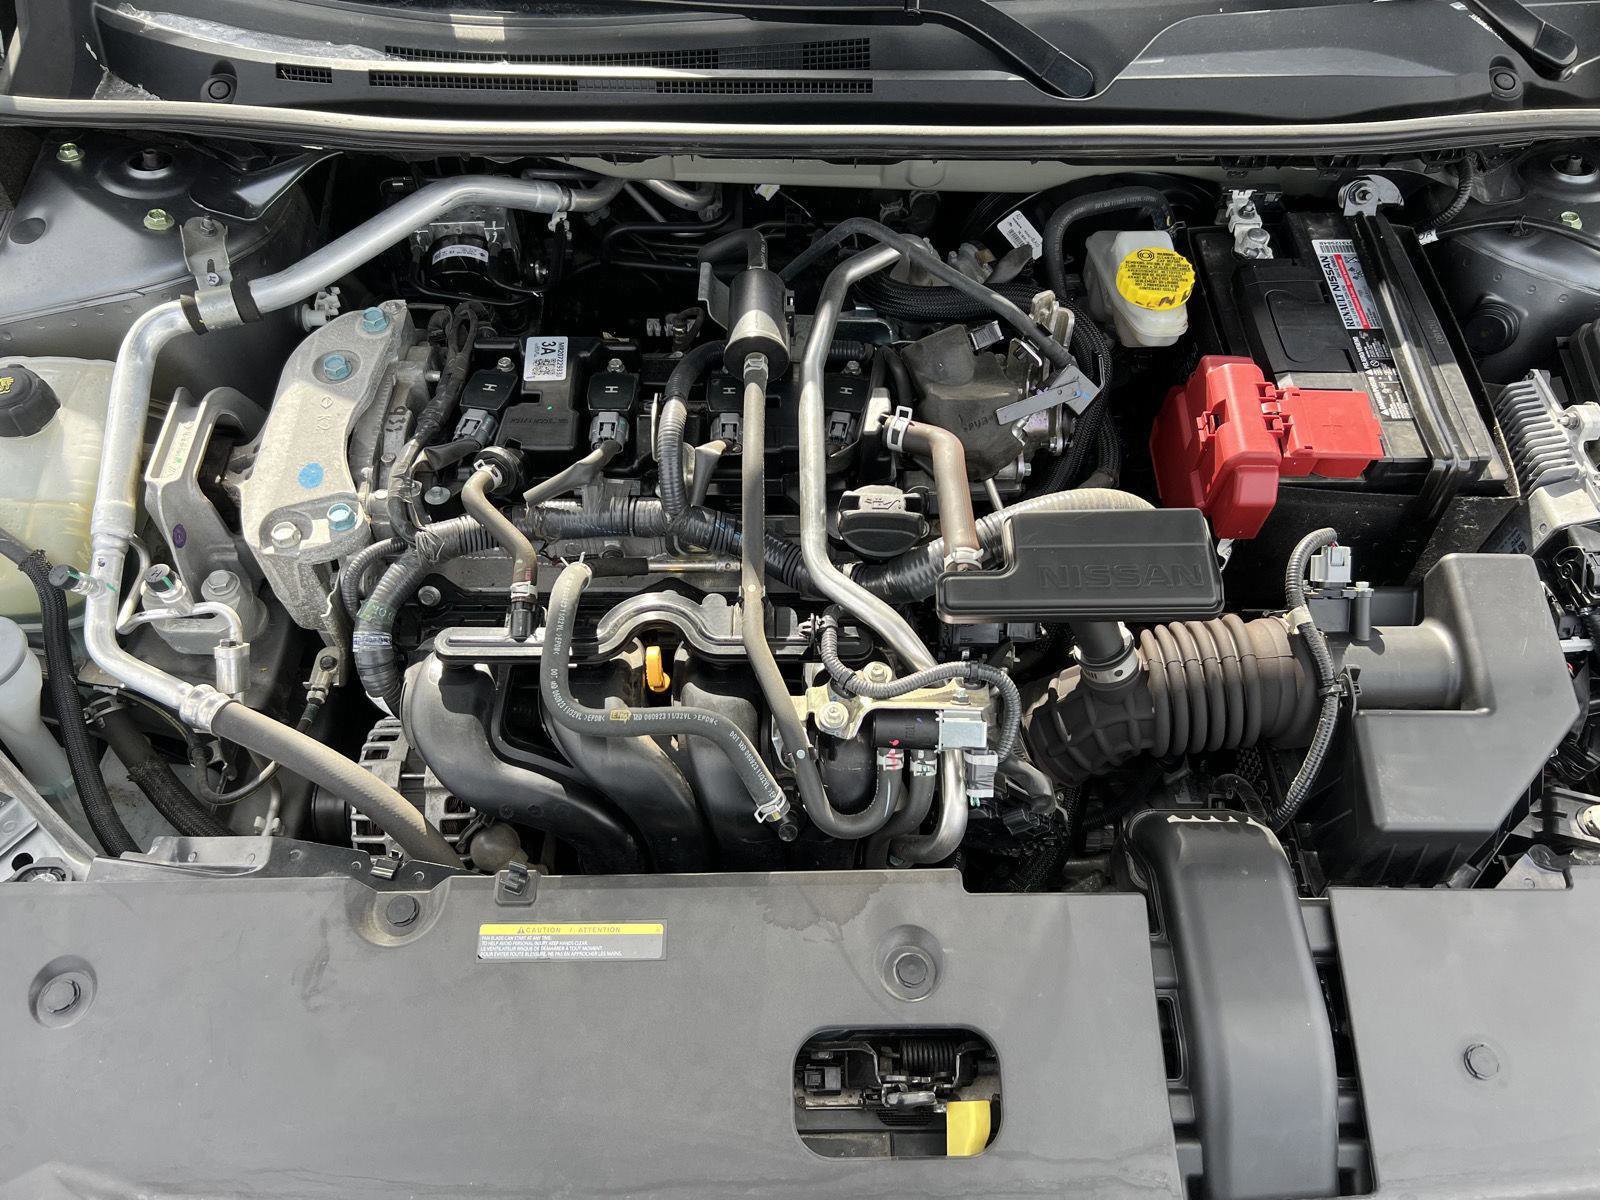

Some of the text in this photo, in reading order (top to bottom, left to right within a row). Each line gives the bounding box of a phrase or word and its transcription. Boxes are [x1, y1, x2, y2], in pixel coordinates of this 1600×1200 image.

[1320, 256, 1341, 292] NISSAN
[1336, 294, 1356, 327] RENAULT
[541, 341, 556, 356] 3A
[1038, 564, 1205, 589] NISSAN
